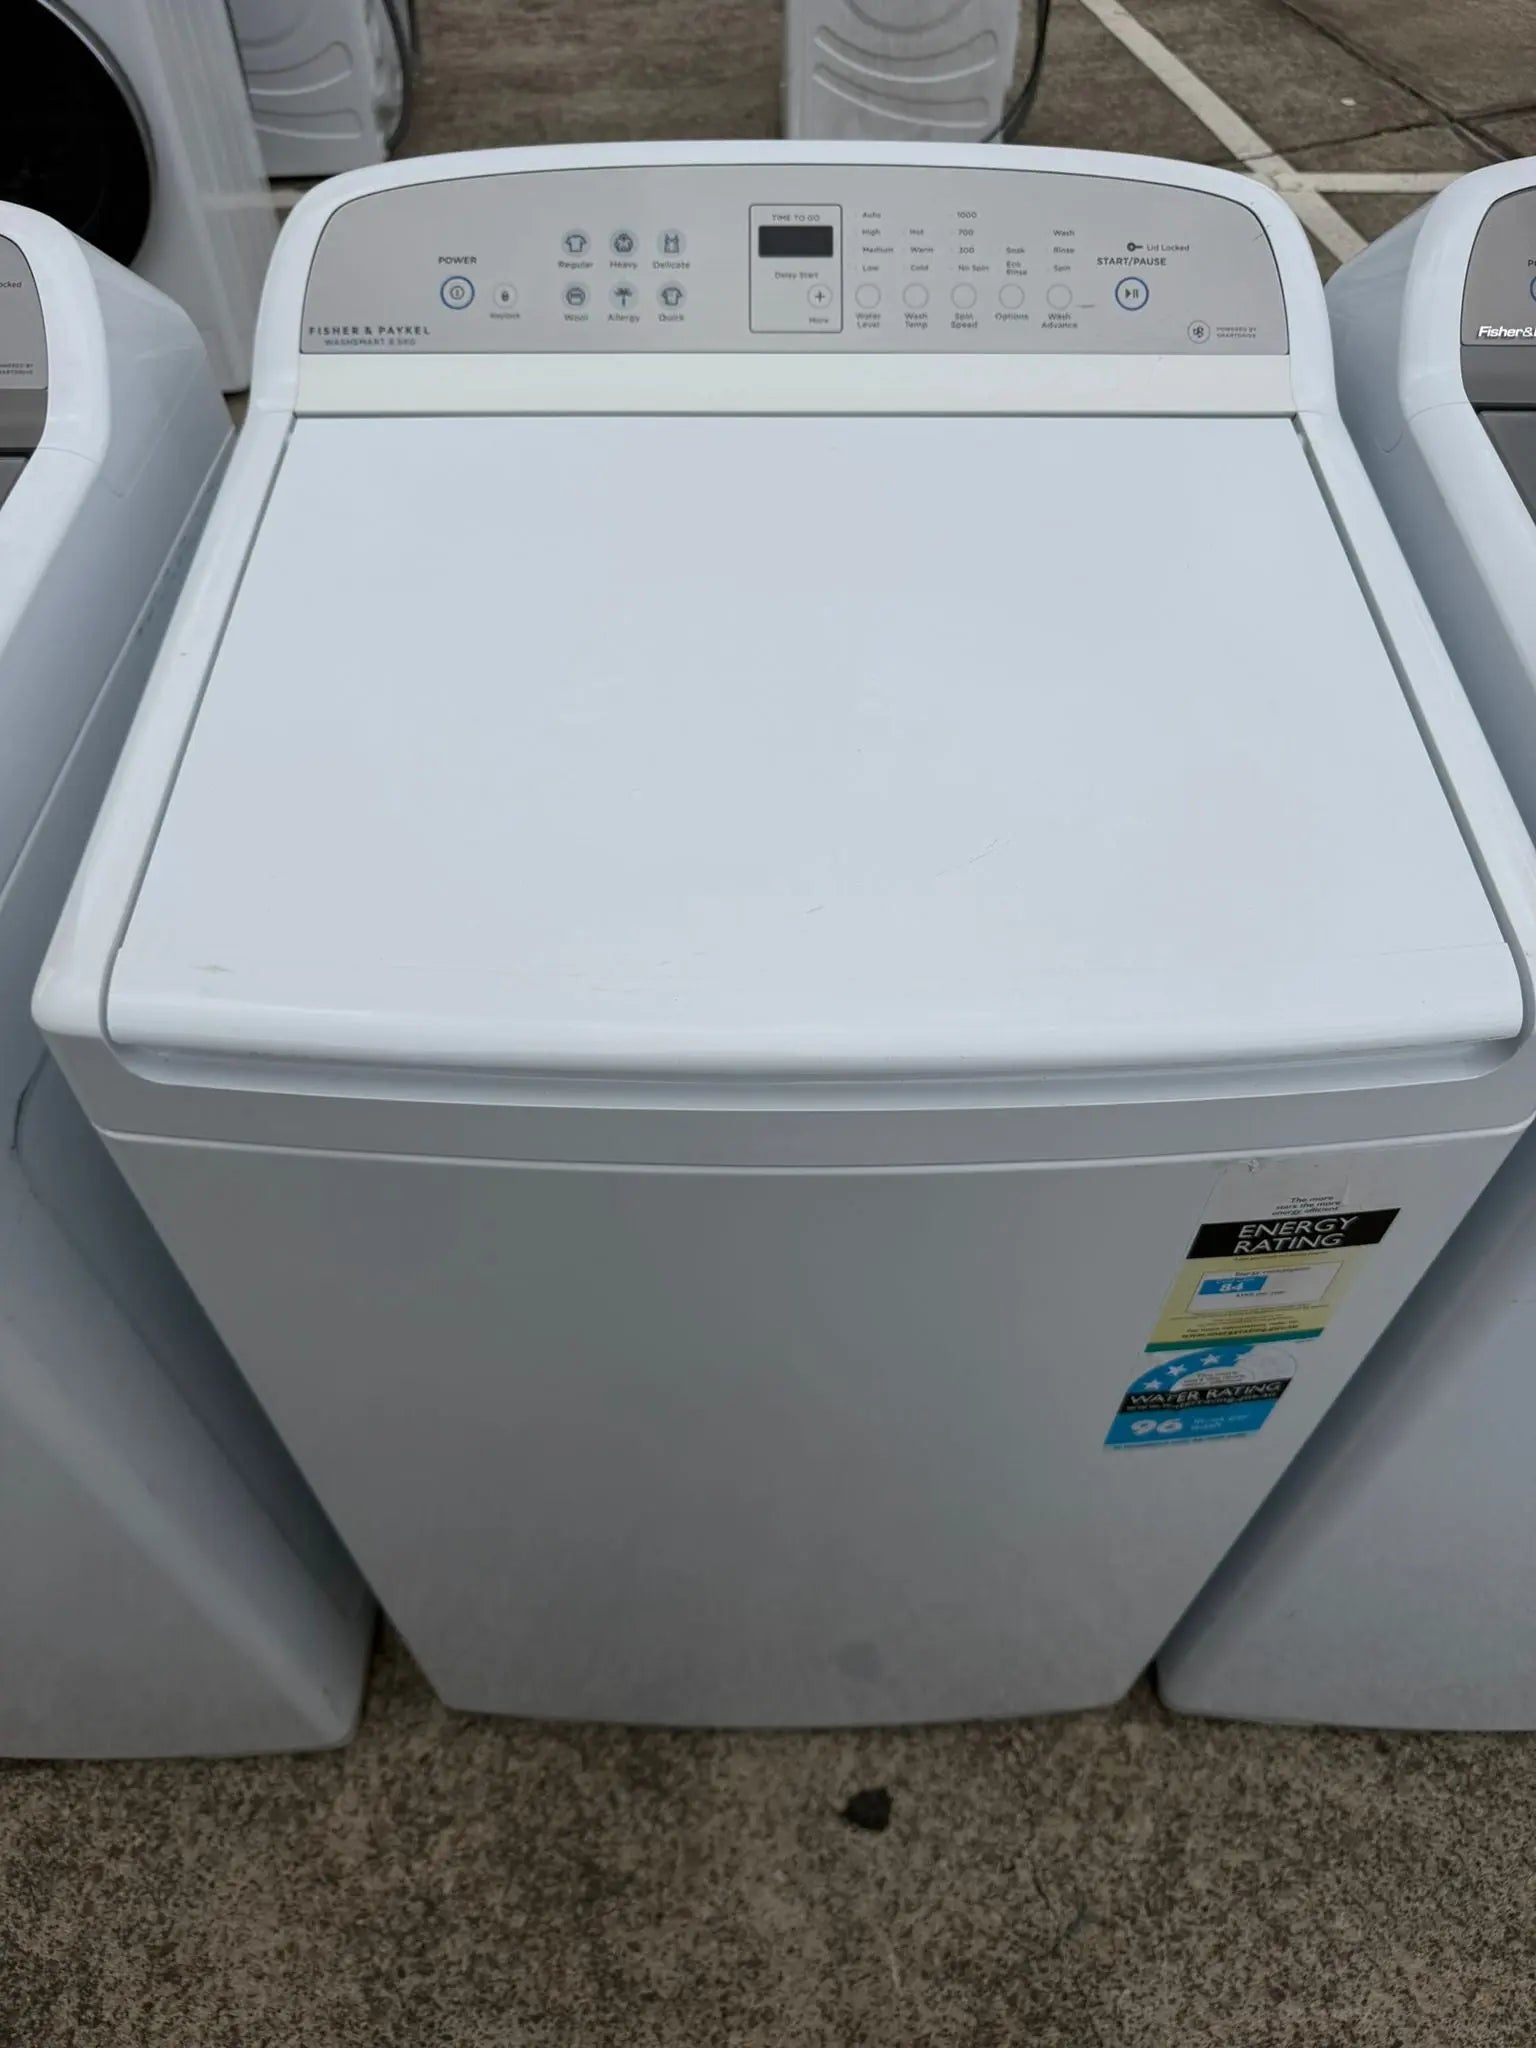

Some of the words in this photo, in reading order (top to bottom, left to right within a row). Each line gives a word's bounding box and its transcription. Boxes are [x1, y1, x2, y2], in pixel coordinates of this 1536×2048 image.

[771, 214, 791, 222] TIME
[794, 214, 805, 222] TO
[807, 214, 820, 222] GO
[862, 212, 881, 220] Auto
[957, 211, 977, 219] 1000
[862, 228, 880, 237] High
[909, 228, 924, 236] Hot
[1053, 229, 1075, 237] Wash
[862, 246, 894, 254] Medium
[910, 246, 934, 254] Warm
[1053, 246, 1075, 254] Rinse
[1146, 244, 1159, 252] Lid
[1161, 244, 1190, 252] Locked
[437, 256, 478, 265] POWER
[557, 260, 594, 270] Regular
[653, 260, 691, 270] Delicate
[1096, 257, 1167, 266] START/PAUSE
[609, 261, 638, 270] Heavy
[862, 264, 879, 272] Low
[910, 264, 929, 272] Cold
[1053, 264, 1072, 273] Spin
[774, 271, 798, 280] Delay
[608, 313, 640, 323] Allergy
[658, 313, 685, 322] Quick
[856, 312, 881, 320] Water
[904, 312, 928, 320] Wash
[955, 312, 974, 321] Spin
[995, 312, 1029, 321] Options
[1048, 312, 1071, 320] Wash
[857, 320, 880, 329] Level
[905, 321, 929, 329] Temp
[951, 320, 978, 329] Speed
[1041, 321, 1078, 329] Advance
[309, 325, 359, 336] FISHER
[365, 325, 373, 336] &
[378, 325, 432, 336] PAYKEL
[324, 337, 385, 346] WASHSMART
[1272, 1208, 1303, 1217] energy
[1304, 1206, 1340, 1214] efficient
[1237, 1216, 1358, 1239] ENERGY
[1232, 1233, 1346, 1254] RATING
[1206, 1381, 1281, 1398] RATING
[1131, 1417, 1184, 1436] 96
